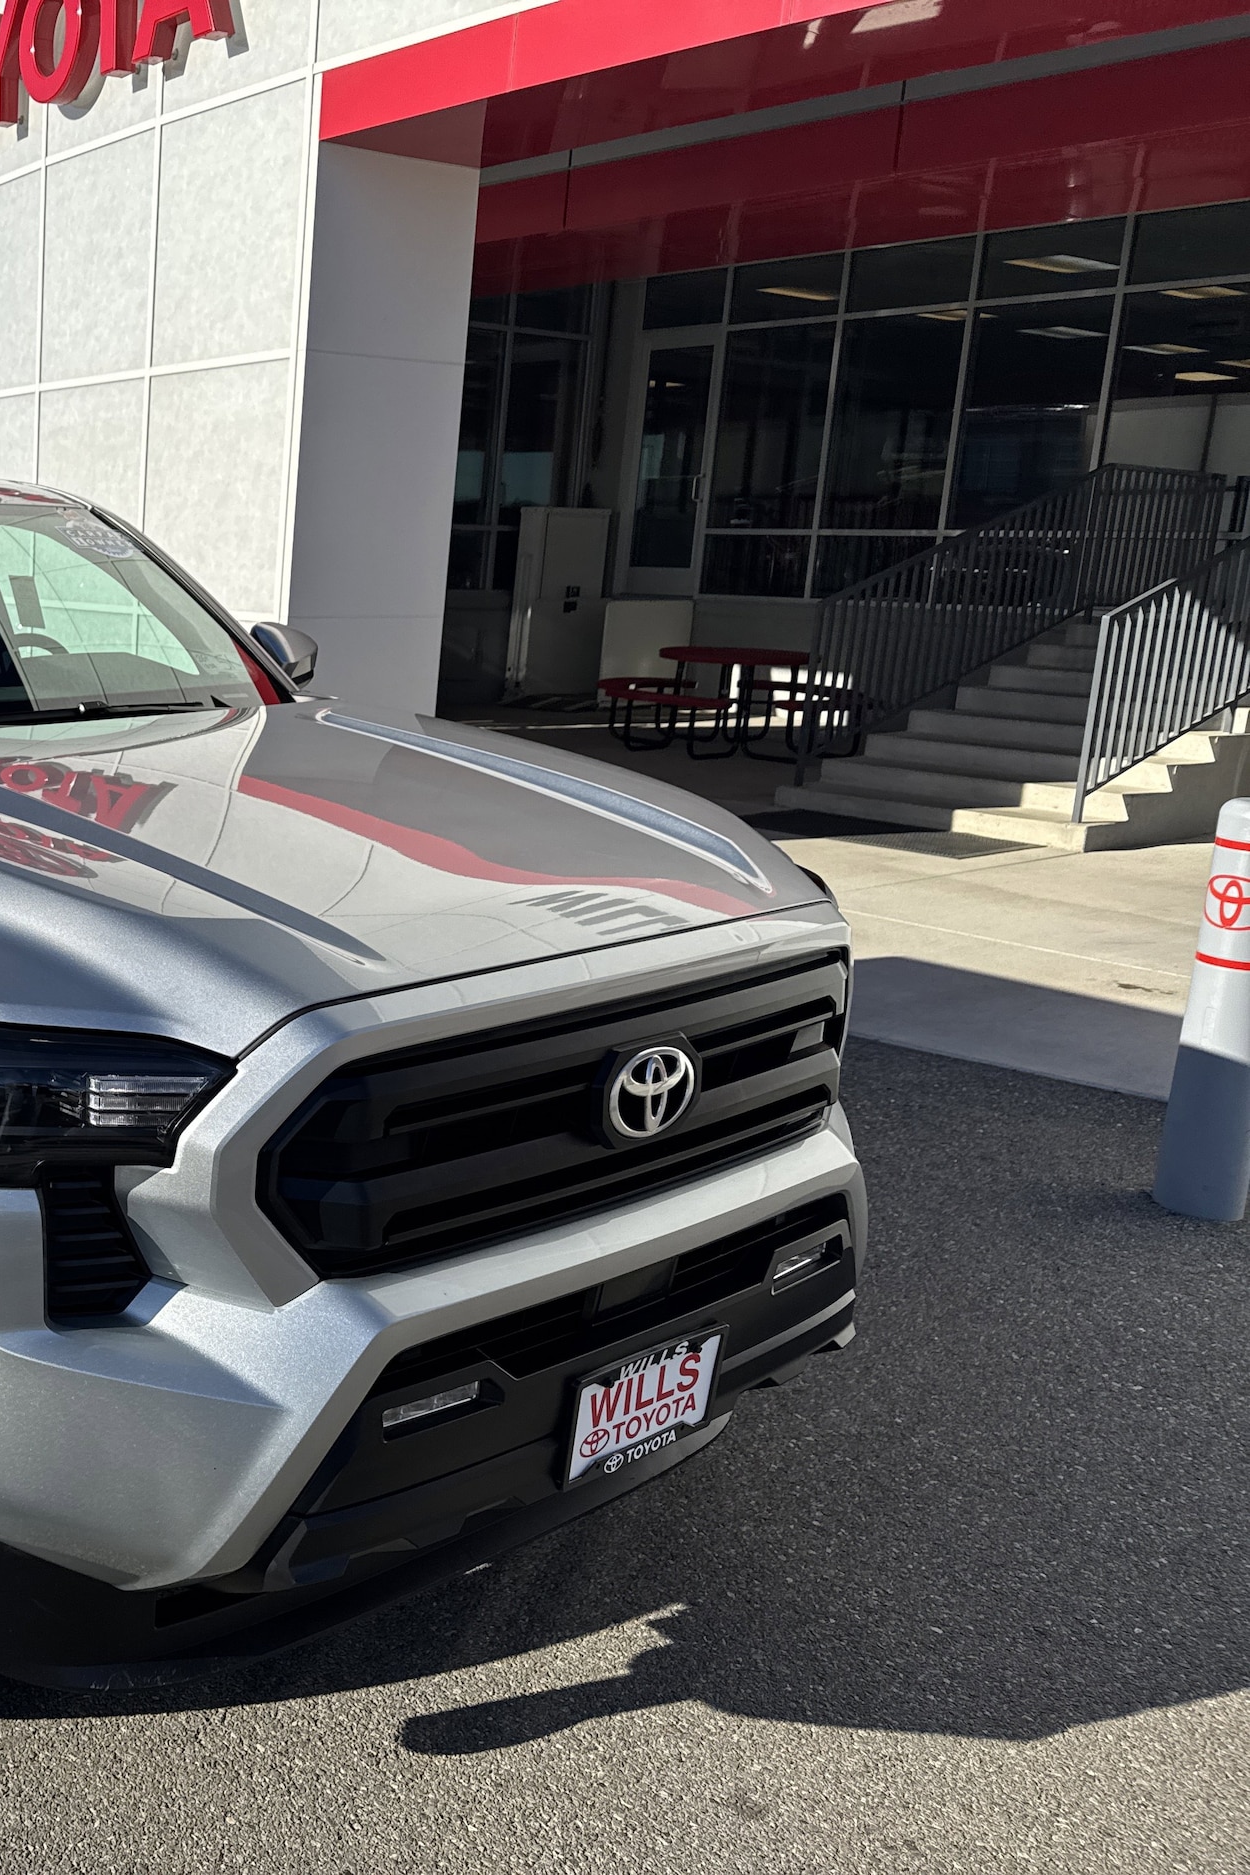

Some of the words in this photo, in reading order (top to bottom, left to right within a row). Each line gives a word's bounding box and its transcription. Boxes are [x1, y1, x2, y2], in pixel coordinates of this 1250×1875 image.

[619, 1340, 689, 1380] WILLS
[590, 1352, 701, 1428] WILLS
[612, 1393, 697, 1444] TOYOTA
[626, 1429, 677, 1463] TOYOTA
